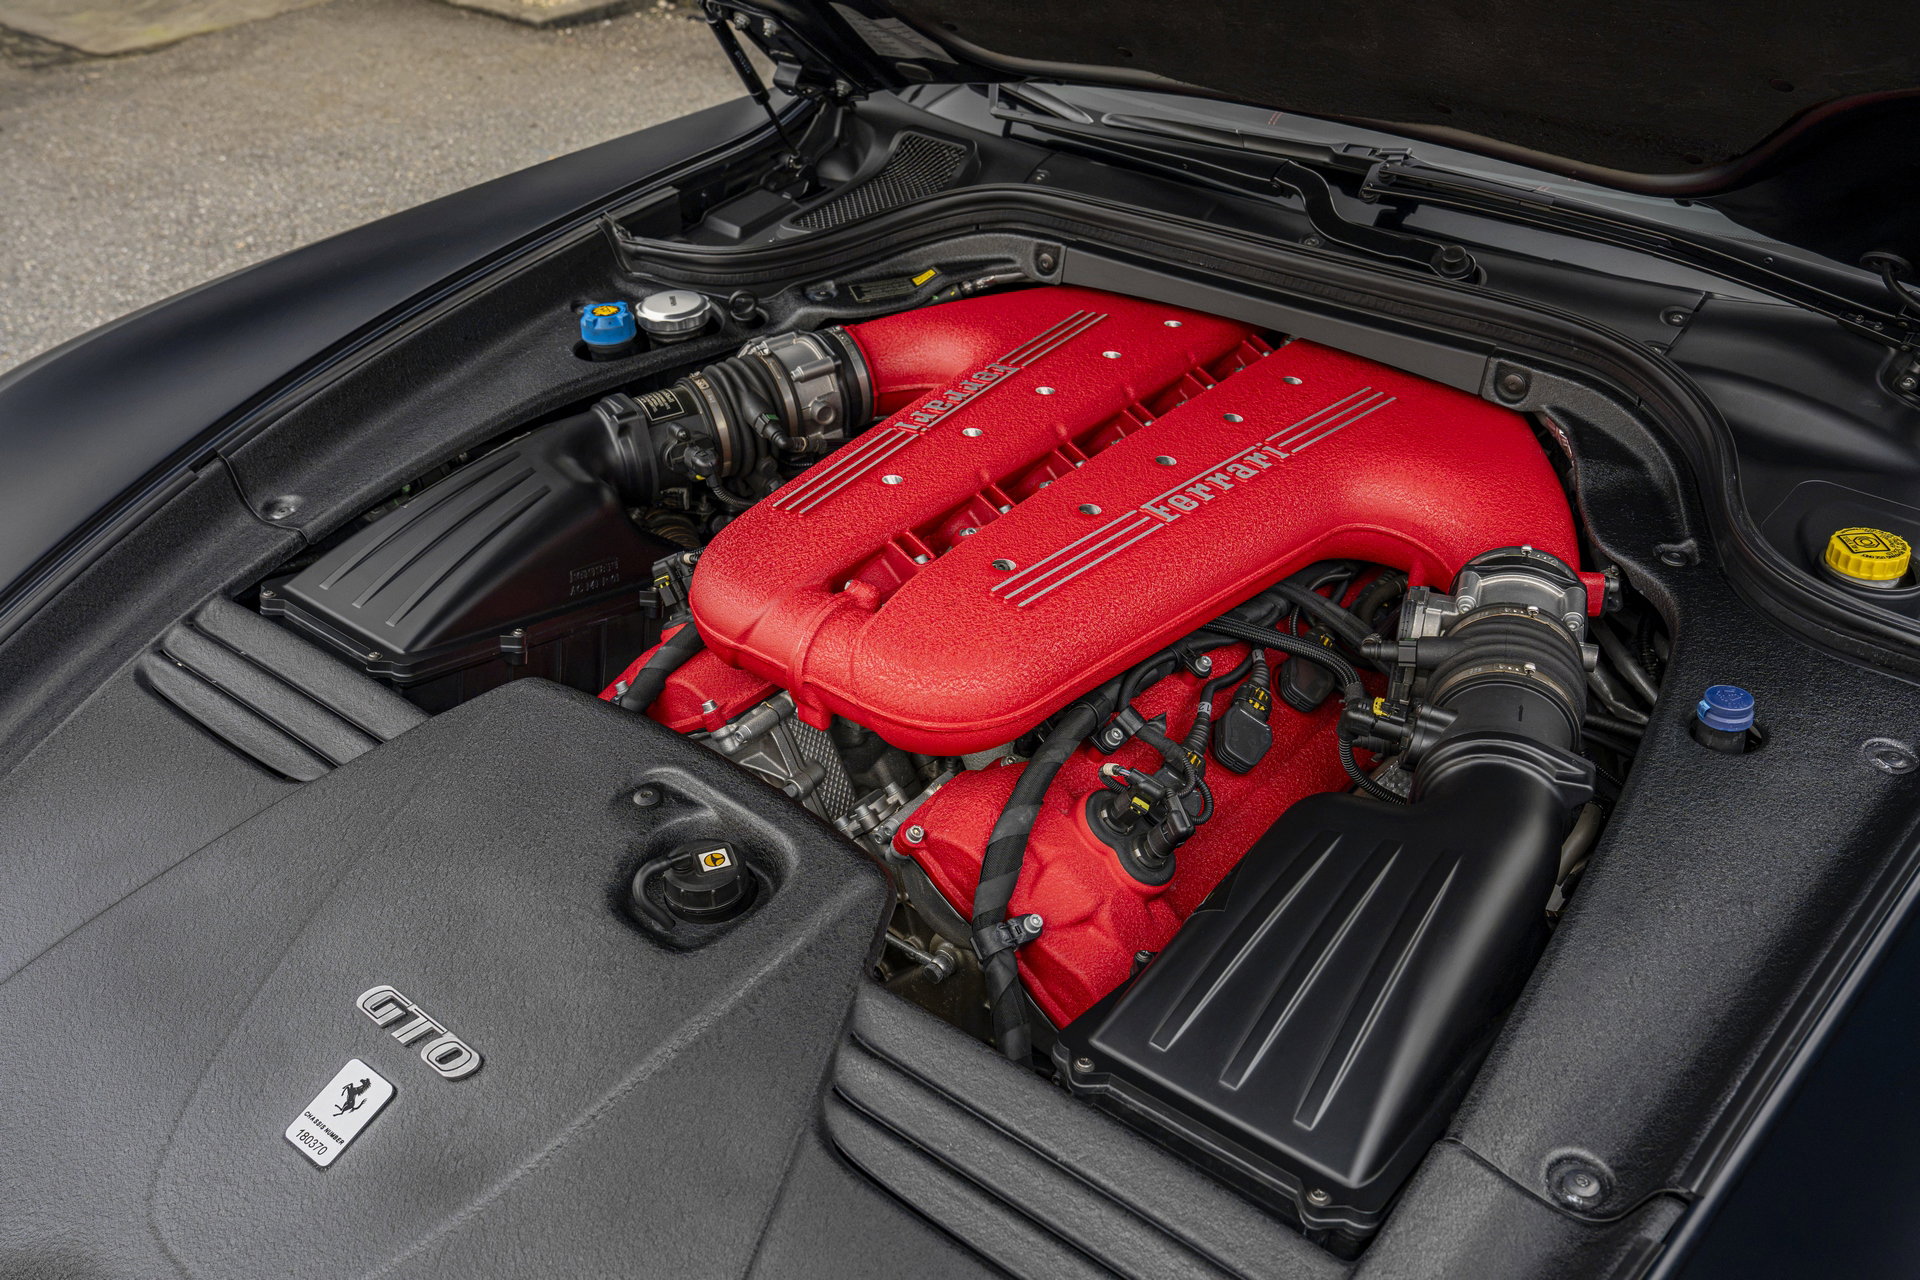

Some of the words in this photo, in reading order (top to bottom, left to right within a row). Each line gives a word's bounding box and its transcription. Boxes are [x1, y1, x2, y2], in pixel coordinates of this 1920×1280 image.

[895, 363, 1020, 434] Ferrari
[1140, 443, 1290, 523] Ferrari
[356, 985, 480, 1080] GTO
[295, 1128, 328, 1156] 180370
[303, 1110, 325, 1131] CHASSIS
[323, 1125, 345, 1146] NUMBER
